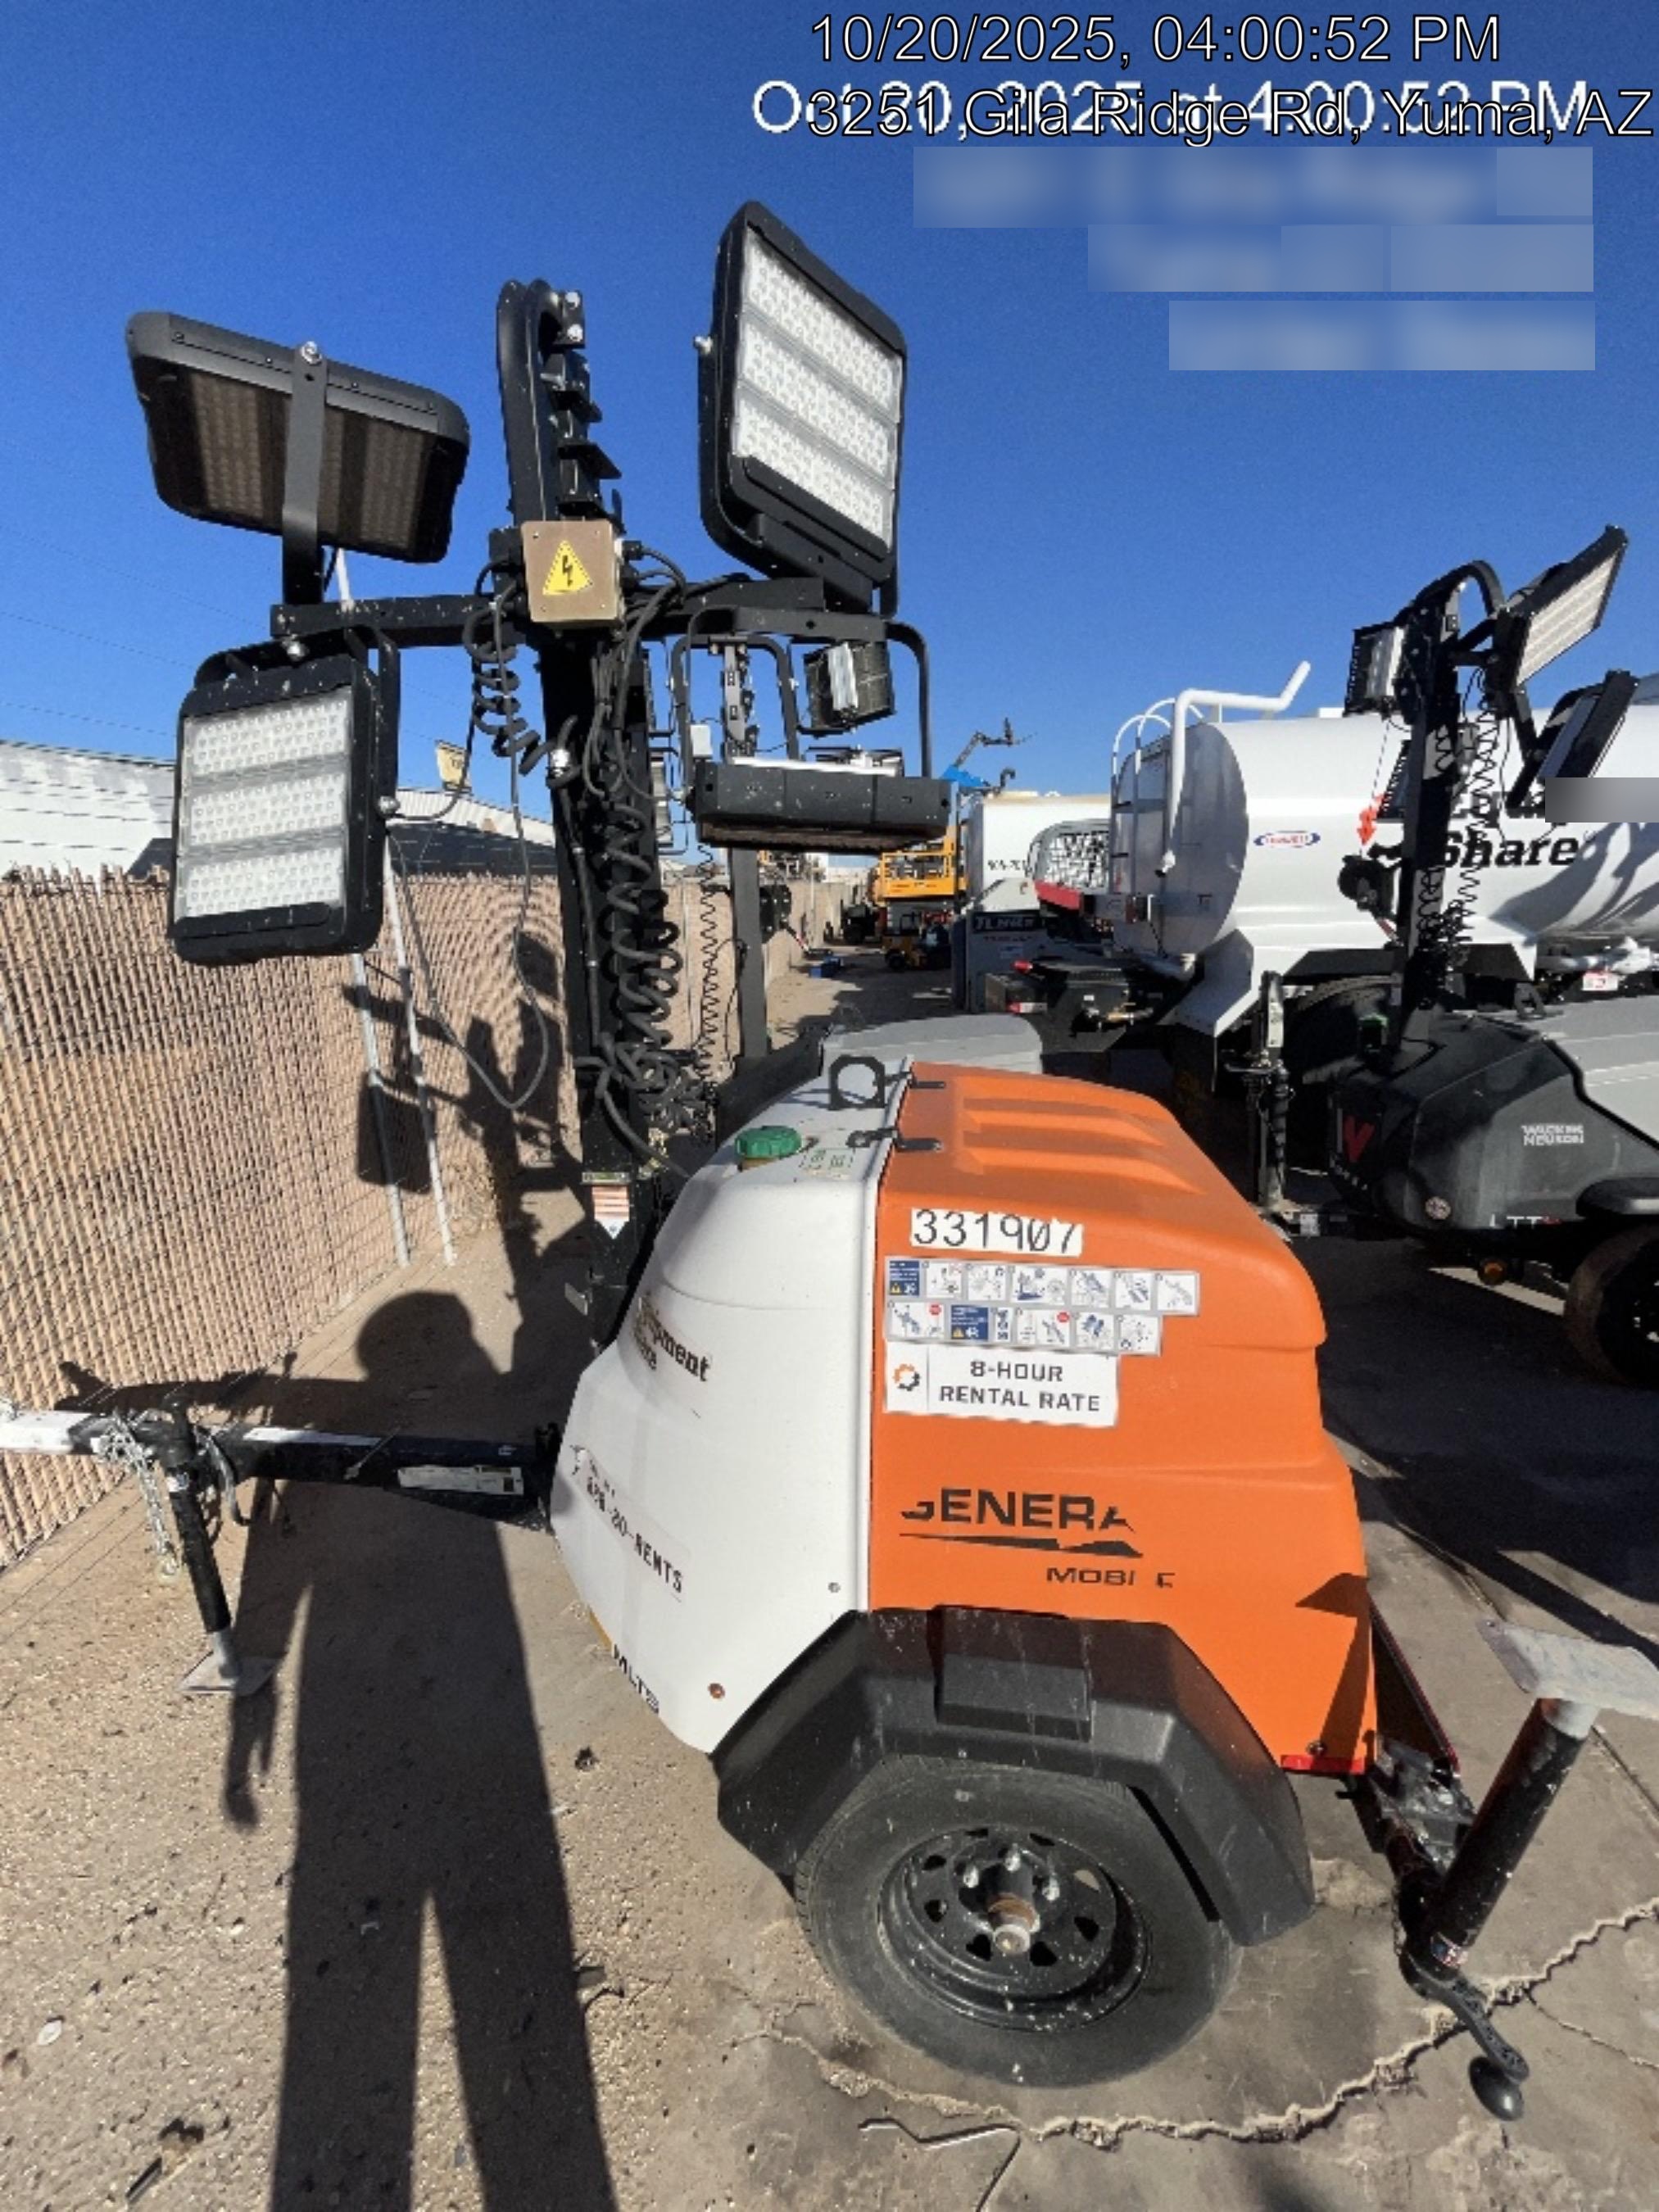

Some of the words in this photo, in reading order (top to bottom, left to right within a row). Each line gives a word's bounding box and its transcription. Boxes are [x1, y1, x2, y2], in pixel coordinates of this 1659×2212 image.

[913, 1208, 1076, 1253] 331907
[969, 1360, 1063, 1382] 8-HOUR
[940, 1385, 1030, 1407] RENTAL
[1039, 1392, 1101, 1412] RATE
[1046, 1567, 1176, 1589] MOBIE
